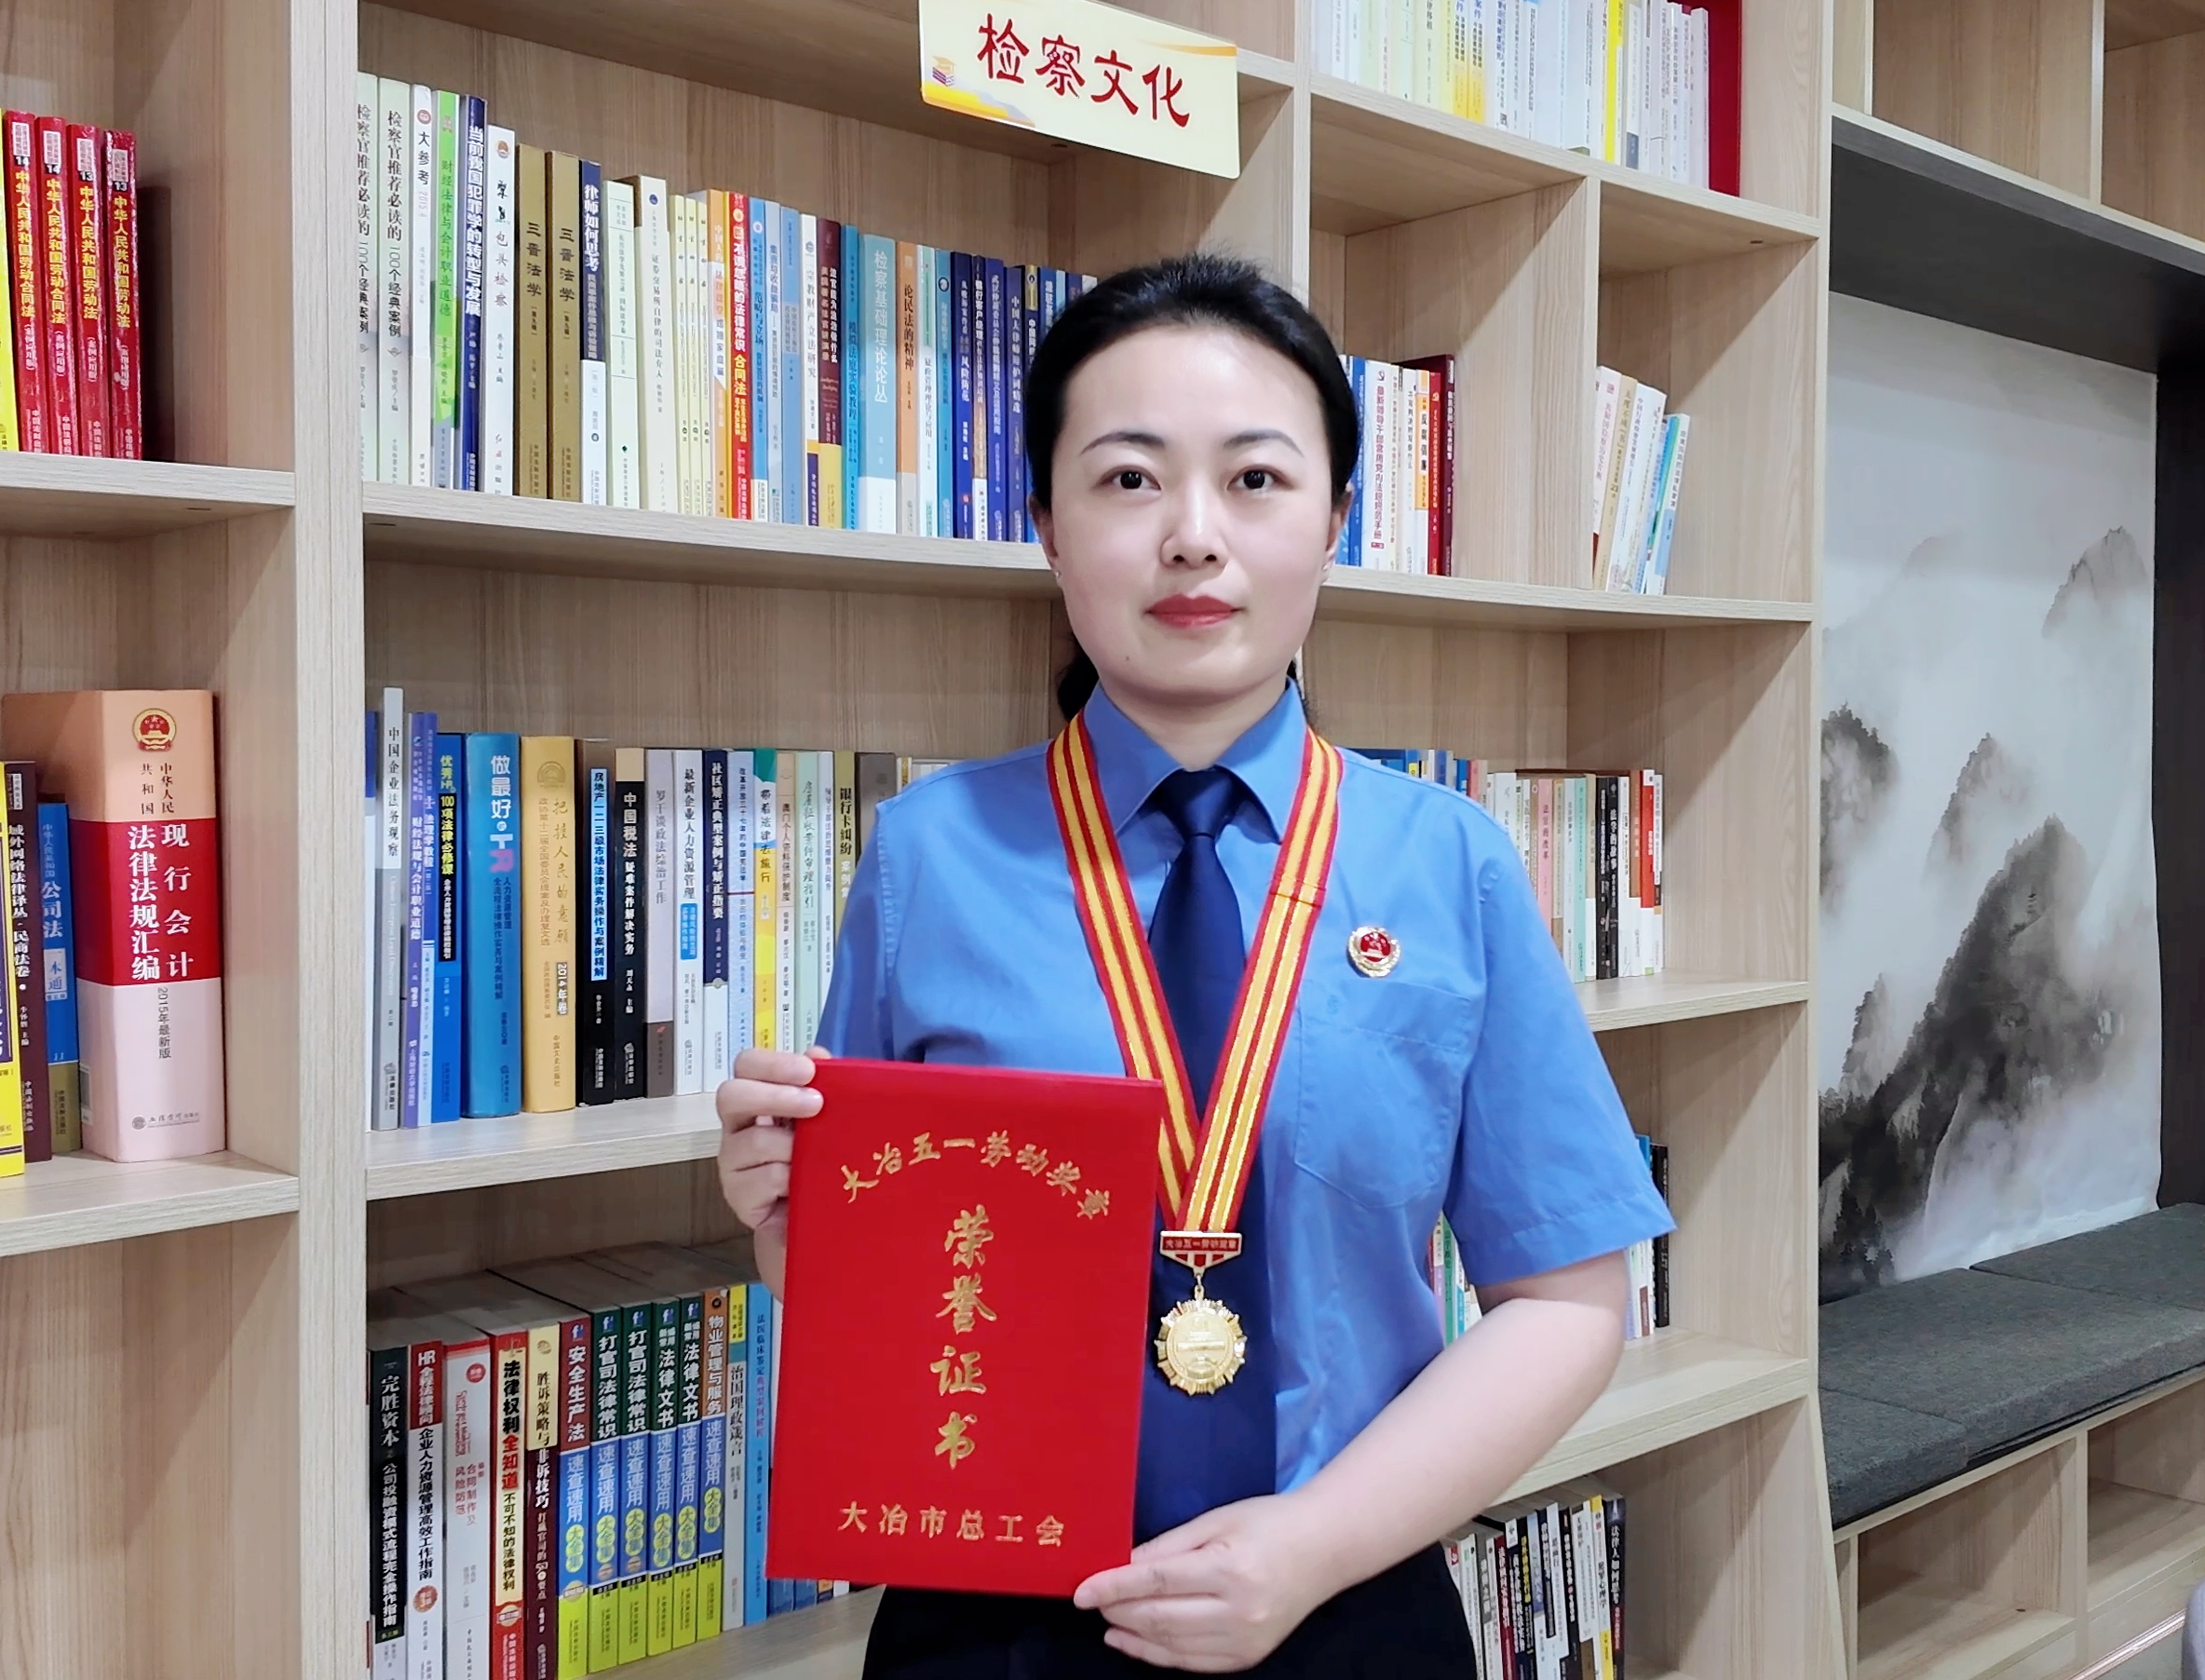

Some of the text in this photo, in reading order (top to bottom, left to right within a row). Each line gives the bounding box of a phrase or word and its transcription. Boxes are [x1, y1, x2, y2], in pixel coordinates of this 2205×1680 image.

[977, 13, 1191, 129] 检察文化
[417, 130, 431, 185] 大参考
[80, 185, 100, 319] 中华人民共和国劳动法
[527, 222, 542, 297] 三晋法学
[559, 227, 575, 302] 三晋法学
[585, 184, 600, 272] 律师如何思考
[873, 250, 888, 403] 检察基础理论论丛
[904, 283, 914, 372] 论民法的精神
[734, 354, 748, 396] 合同法
[141, 764, 155, 815] 共和国
[160, 763, 175, 814] 中华人民
[387, 727, 401, 858] 中国企业法务观察
[622, 792, 638, 859] 中国税法
[840, 787, 853, 856] 银行卡纠纷
[655, 789, 667, 905] 罗干谈政法综治工作
[683, 767, 696, 900] 最新企业人力资源管理
[781, 802, 791, 902] 澳门个人资料保护制度
[41, 881, 63, 939] 公司法
[128, 825, 161, 981] 法律法规汇编
[161, 823, 195, 977] 现行会计
[157, 986, 172, 1060] 2015年最新版
[707, 1315, 724, 1416] 物业管理与服务
[930, 1204, 997, 1470] 荣誉证书
[381, 1375, 400, 1447] 完胜资本
[503, 1360, 521, 1434] 法律权利
[566, 1346, 587, 1443] 安全生产法
[598, 1334, 617, 1440] 打官司法律常识
[627, 1329, 648, 1433] 打官司法律常识
[657, 1348, 675, 1429] 法律文书
[682, 1342, 700, 1423] 法律文书
[502, 1434, 520, 1491] 全知道
[566, 1454, 585, 1525] 速查速用
[597, 1444, 616, 1516] 速查速用
[626, 1438, 645, 1509] 速查速用
[656, 1431, 673, 1511] 速查速用
[681, 1425, 698, 1504] 速查速用
[705, 1419, 723, 1487] 速查速用
[418, 1427, 434, 1581] 企业人力资源管理高效工作指南
[503, 1492, 516, 1592] 不可不知的法律权利
[838, 1500, 1065, 1548] 大冶市总工会
